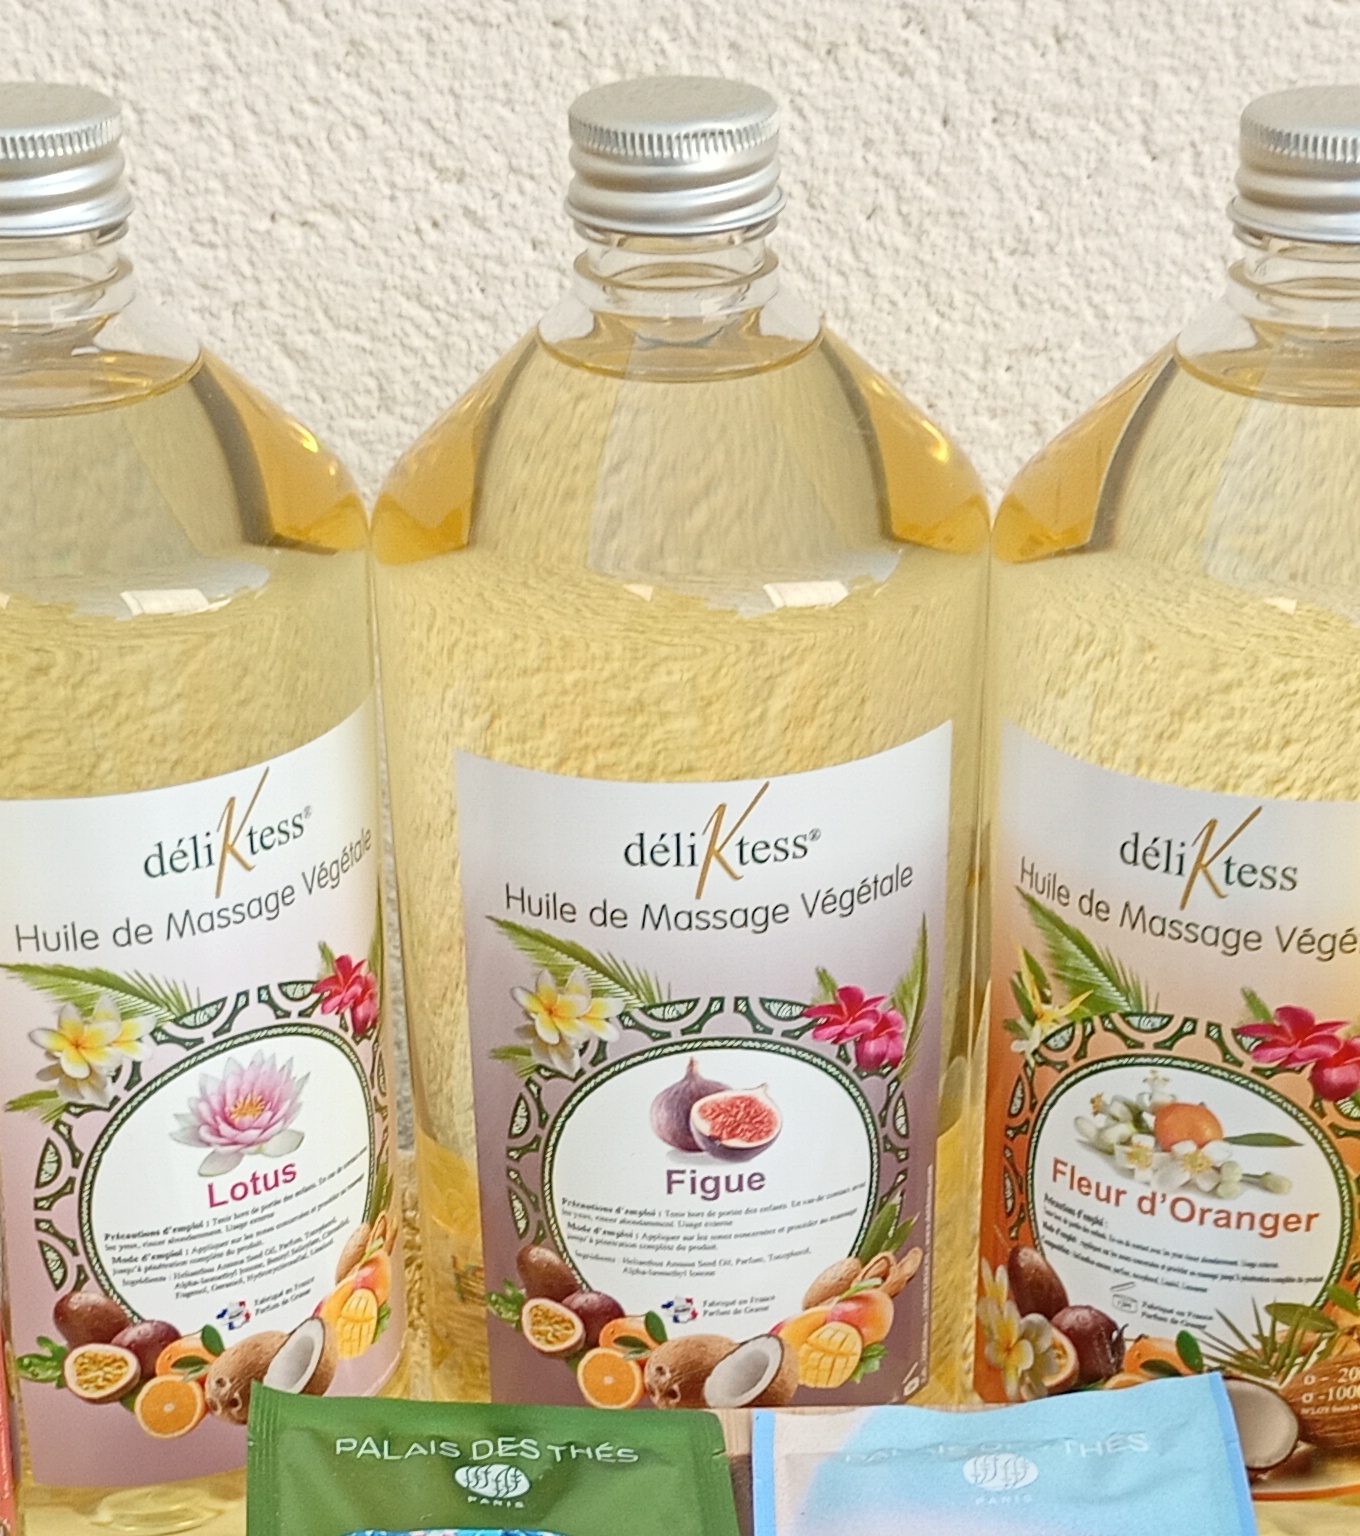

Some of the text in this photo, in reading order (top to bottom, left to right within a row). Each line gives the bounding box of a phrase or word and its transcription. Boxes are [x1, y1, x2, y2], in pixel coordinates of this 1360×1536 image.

[15, 826, 372, 952] Huile de Massage Végétale
[1119, 806, 1297, 910] déliKtess
[505, 863, 913, 934] Huile de Massage Végétale
[1020, 856, 1070, 907] Huile
[1078, 889, 1111, 921] de
[1119, 901, 1262, 956] Massage
[207, 1161, 298, 1209] Lotus
[666, 1169, 766, 1200] Figue
[1052, 1158, 1319, 1238] Fleur d'Oranger
[335, 1437, 639, 1464] PALAIS DES THÉS
